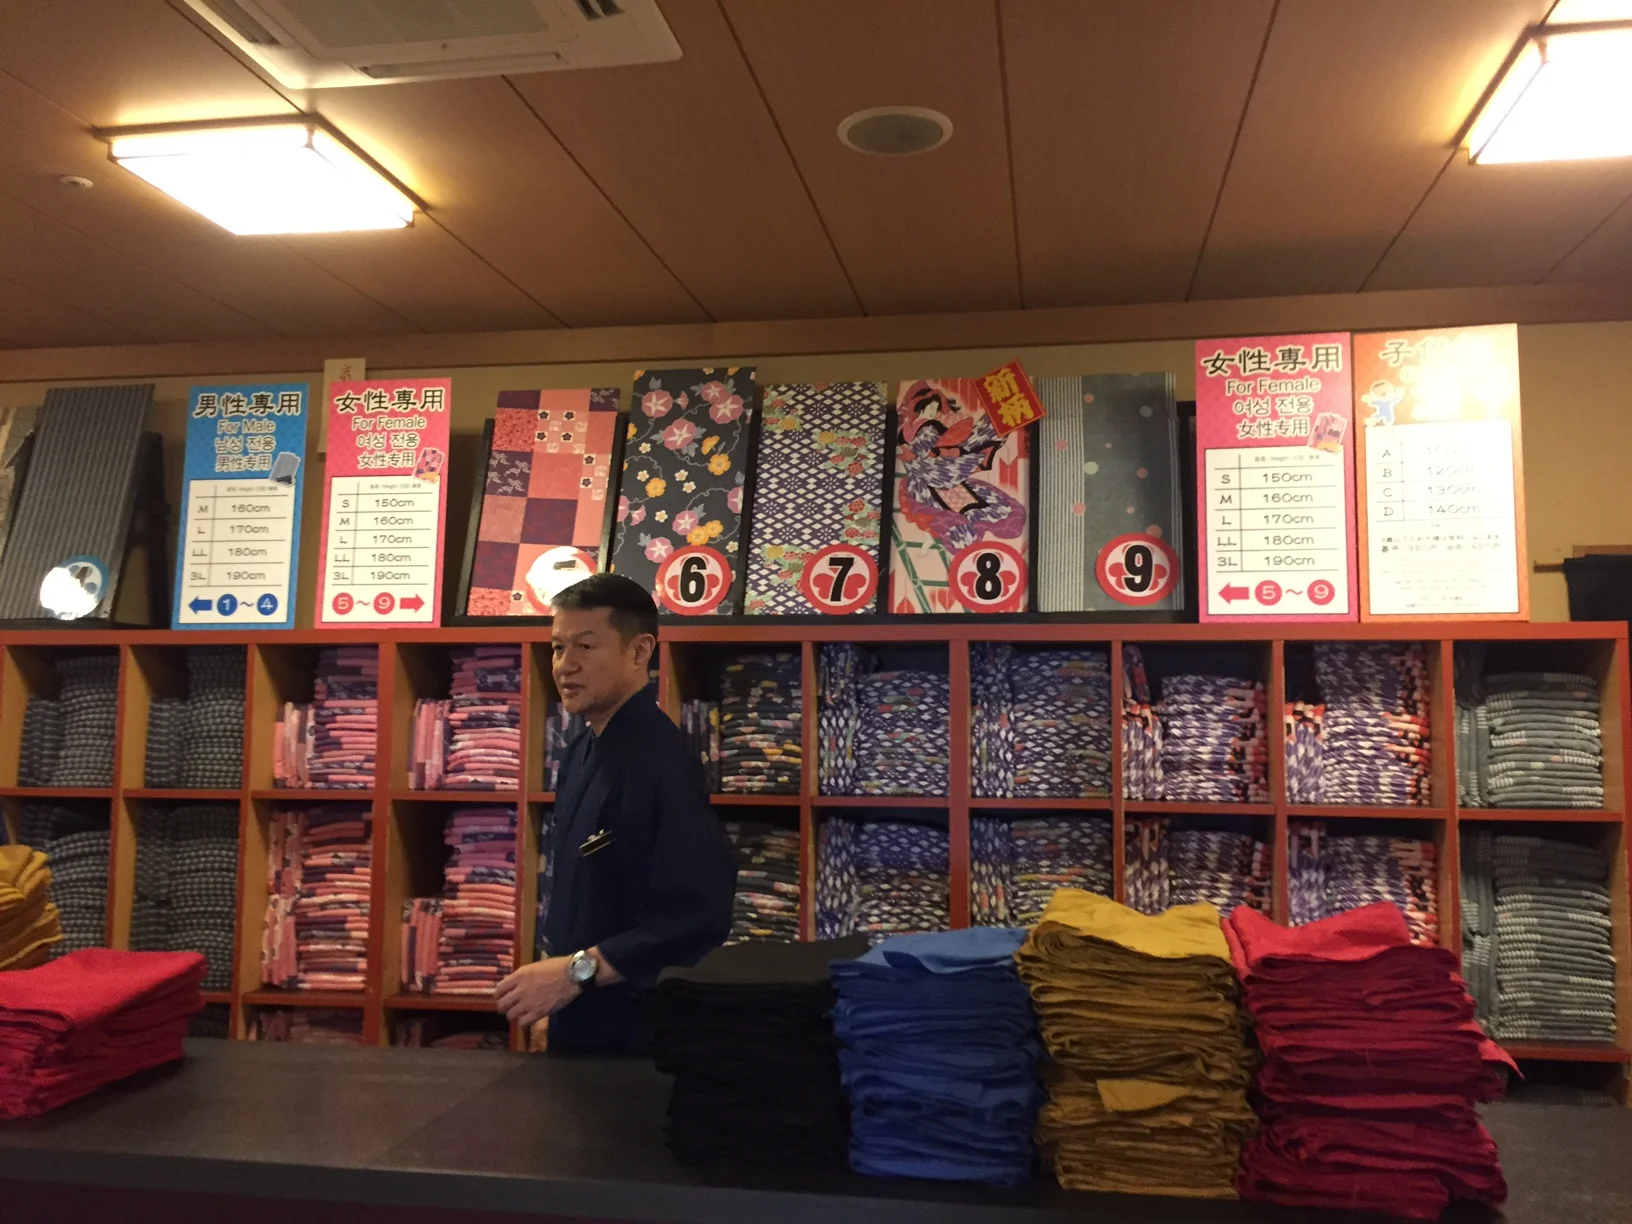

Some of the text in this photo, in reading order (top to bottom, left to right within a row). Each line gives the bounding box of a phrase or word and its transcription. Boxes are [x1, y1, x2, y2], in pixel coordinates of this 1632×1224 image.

[1226, 378, 1320, 395] For Female
[983, 367, 1034, 428] 新柄
[1234, 397, 1312, 416] 여성 전용
[218, 419, 276, 433] For Male
[352, 416, 426, 430] For Female
[1238, 418, 1309, 438] 女性专用
[215, 435, 276, 453] 남성 전용
[357, 433, 419, 449] 여성 전용
[1382, 449, 1392, 458] A
[216, 454, 272, 471] 男性专用
[358, 452, 415, 468] 女性专用
[1221, 472, 1313, 484] S 150cm
[1383, 468, 1392, 478] B
[1383, 485, 1480, 497] C 130cm
[342, 498, 415, 508] S 150cm
[1219, 493, 1314, 504] M 160cm
[197, 504, 271, 514] M 160cm
[1383, 504, 1481, 517] D 140cm
[339, 516, 413, 526] M 160cm
[1221, 514, 1314, 525] L 170cm
[197, 525, 269, 535] L 170cm
[339, 535, 412, 544] L 170cm
[1217, 535, 1315, 546] LL 180cm
[192, 547, 267, 557] LL 180cm
[334, 553, 412, 563] LL 180cm
[1217, 555, 1315, 567] 3L 190cm
[1123, 544, 1153, 593] 9
[190, 571, 266, 581] 3L 190cm
[333, 570, 411, 580] 3L 190cm
[680, 555, 707, 603] 6
[828, 556, 855, 603] 7
[975, 552, 1002, 600] 8
